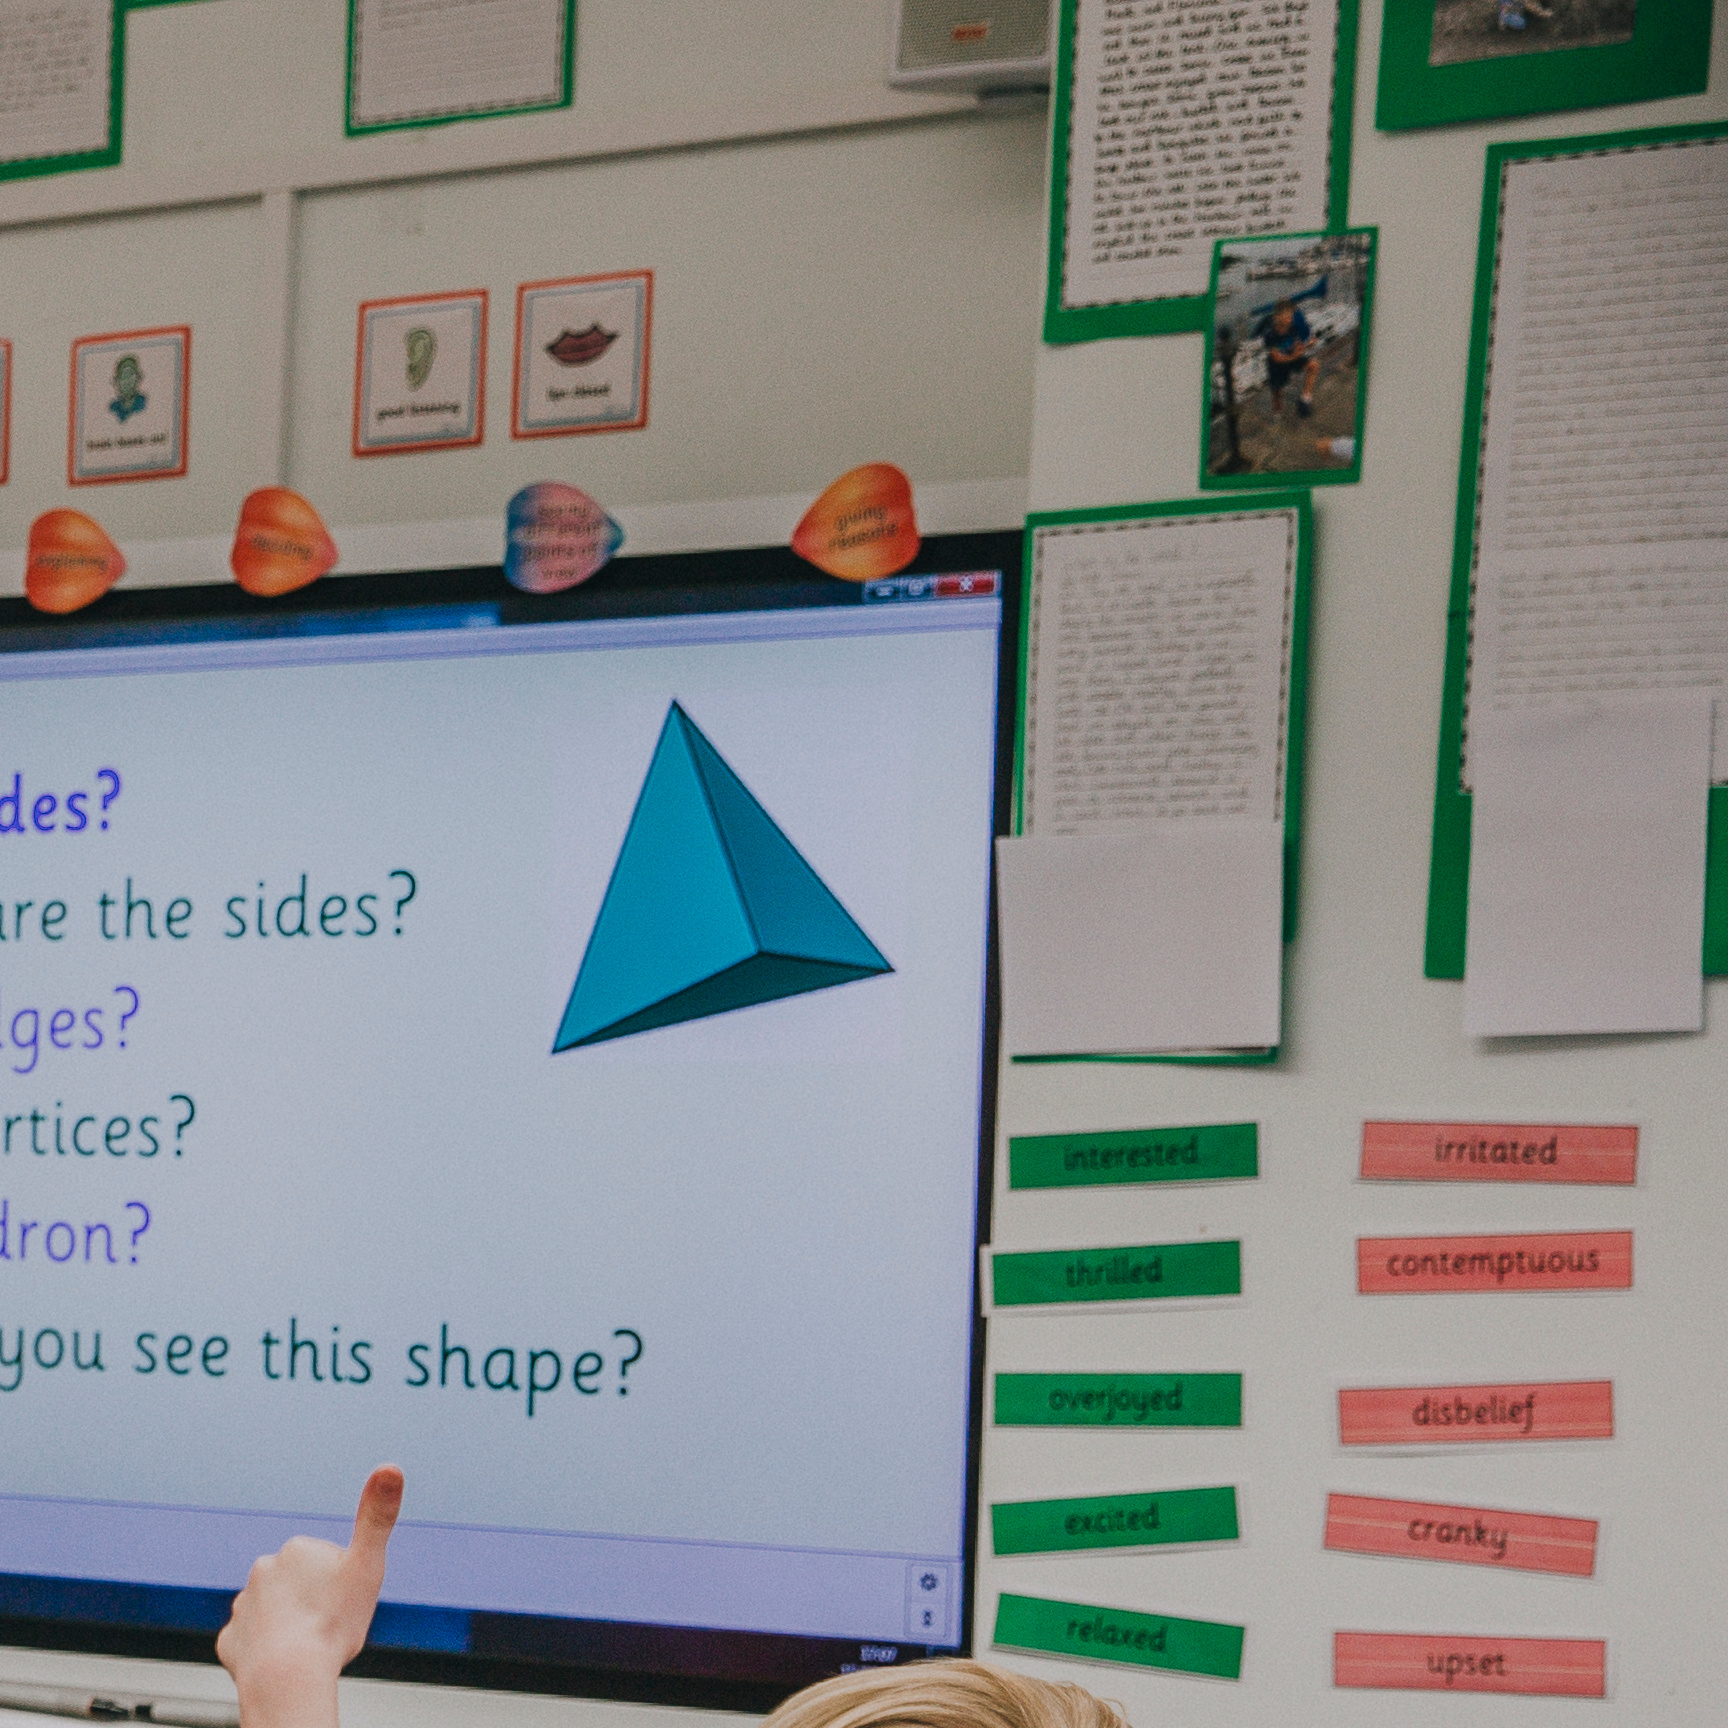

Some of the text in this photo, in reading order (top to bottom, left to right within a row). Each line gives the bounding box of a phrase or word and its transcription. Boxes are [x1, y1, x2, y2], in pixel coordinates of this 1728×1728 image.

[96, 875, 195, 942] the
[223, 868, 419, 941] sides?
[1062, 1135, 1201, 1175] interested
[1434, 1134, 1559, 1168] irritated
[1063, 1255, 1165, 1288] thrilled
[1385, 1245, 1602, 1285] contemptuous
[133, 1330, 231, 1379] see
[261, 1316, 375, 1387] this
[405, 1320, 645, 1420] shape?
[1048, 1380, 1185, 1423] overjoyed
[1411, 1392, 1538, 1435] disbelief
[1063, 1503, 1163, 1536] excited
[1406, 1515, 1510, 1561] cranky
[1065, 1613, 1169, 1656] relaxed
[1425, 1648, 1507, 1686] upset
